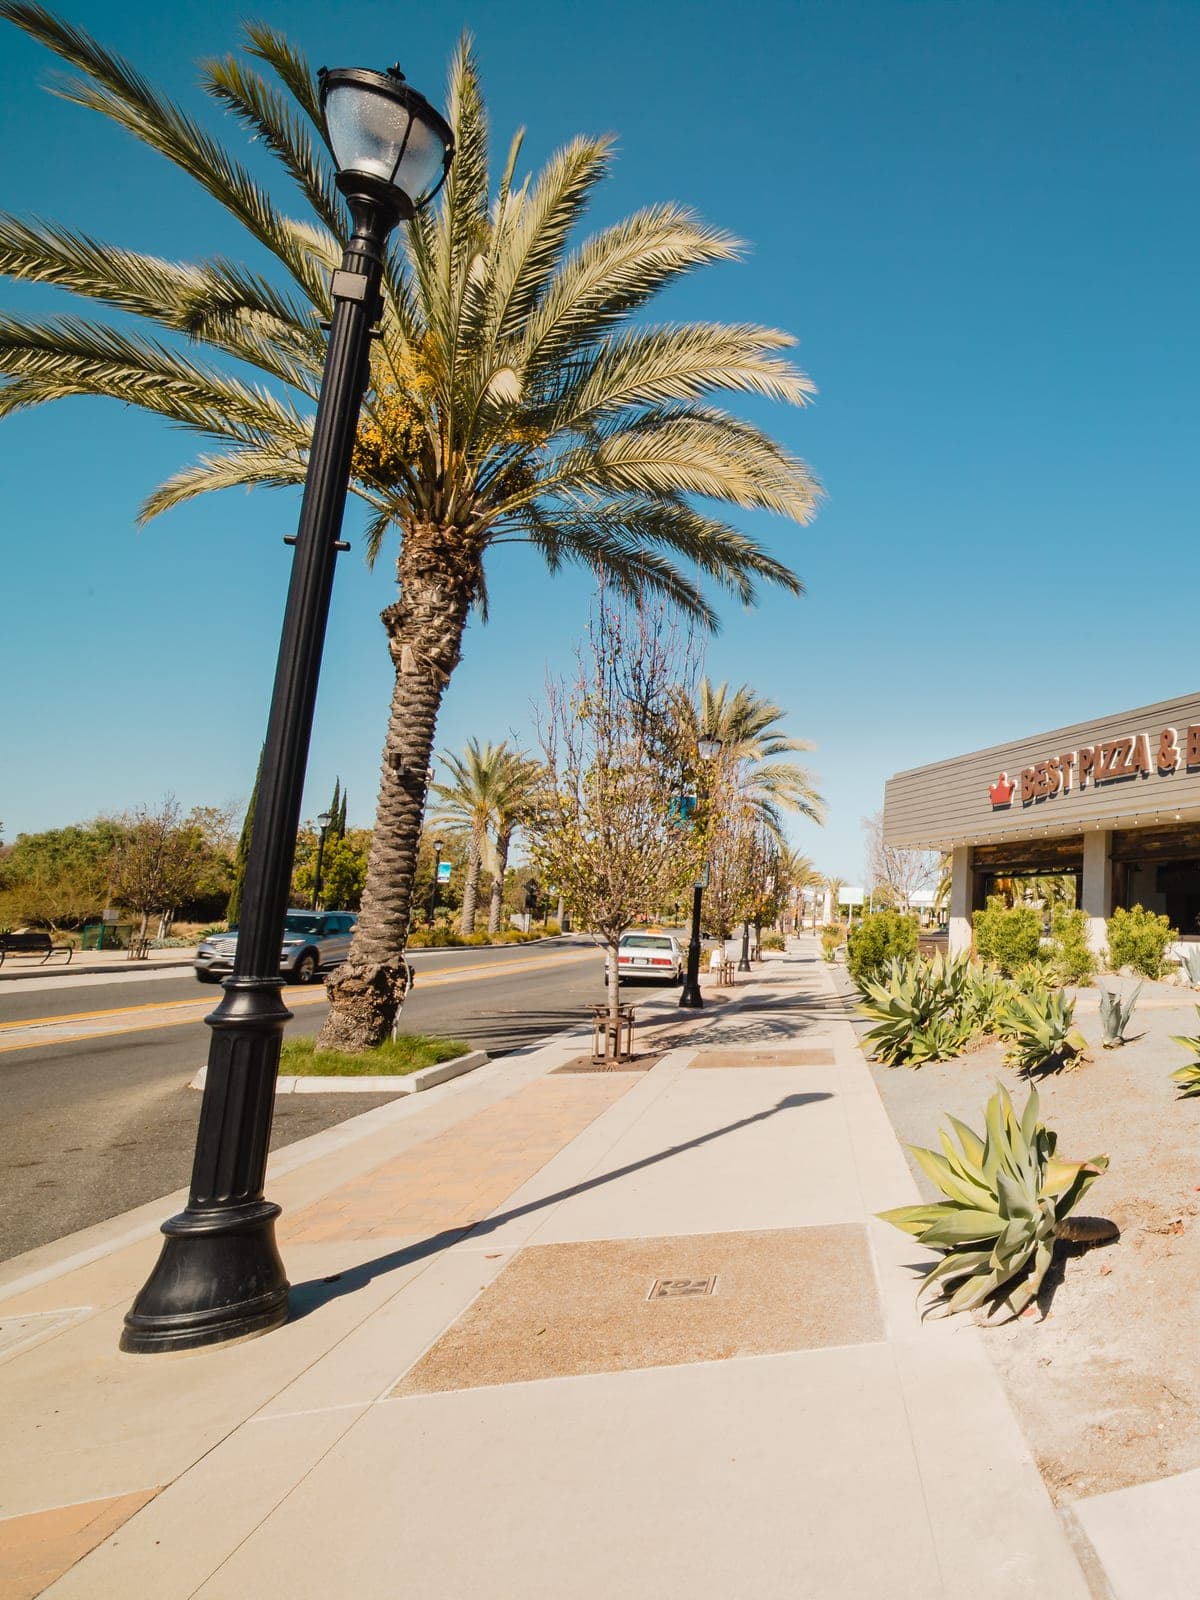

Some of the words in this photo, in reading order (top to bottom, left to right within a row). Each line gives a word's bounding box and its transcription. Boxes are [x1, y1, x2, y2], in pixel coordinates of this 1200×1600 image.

[1021, 751, 1077, 804] BEST
[1079, 733, 1153, 785] PIZZA
[1157, 728, 1181, 771] &
